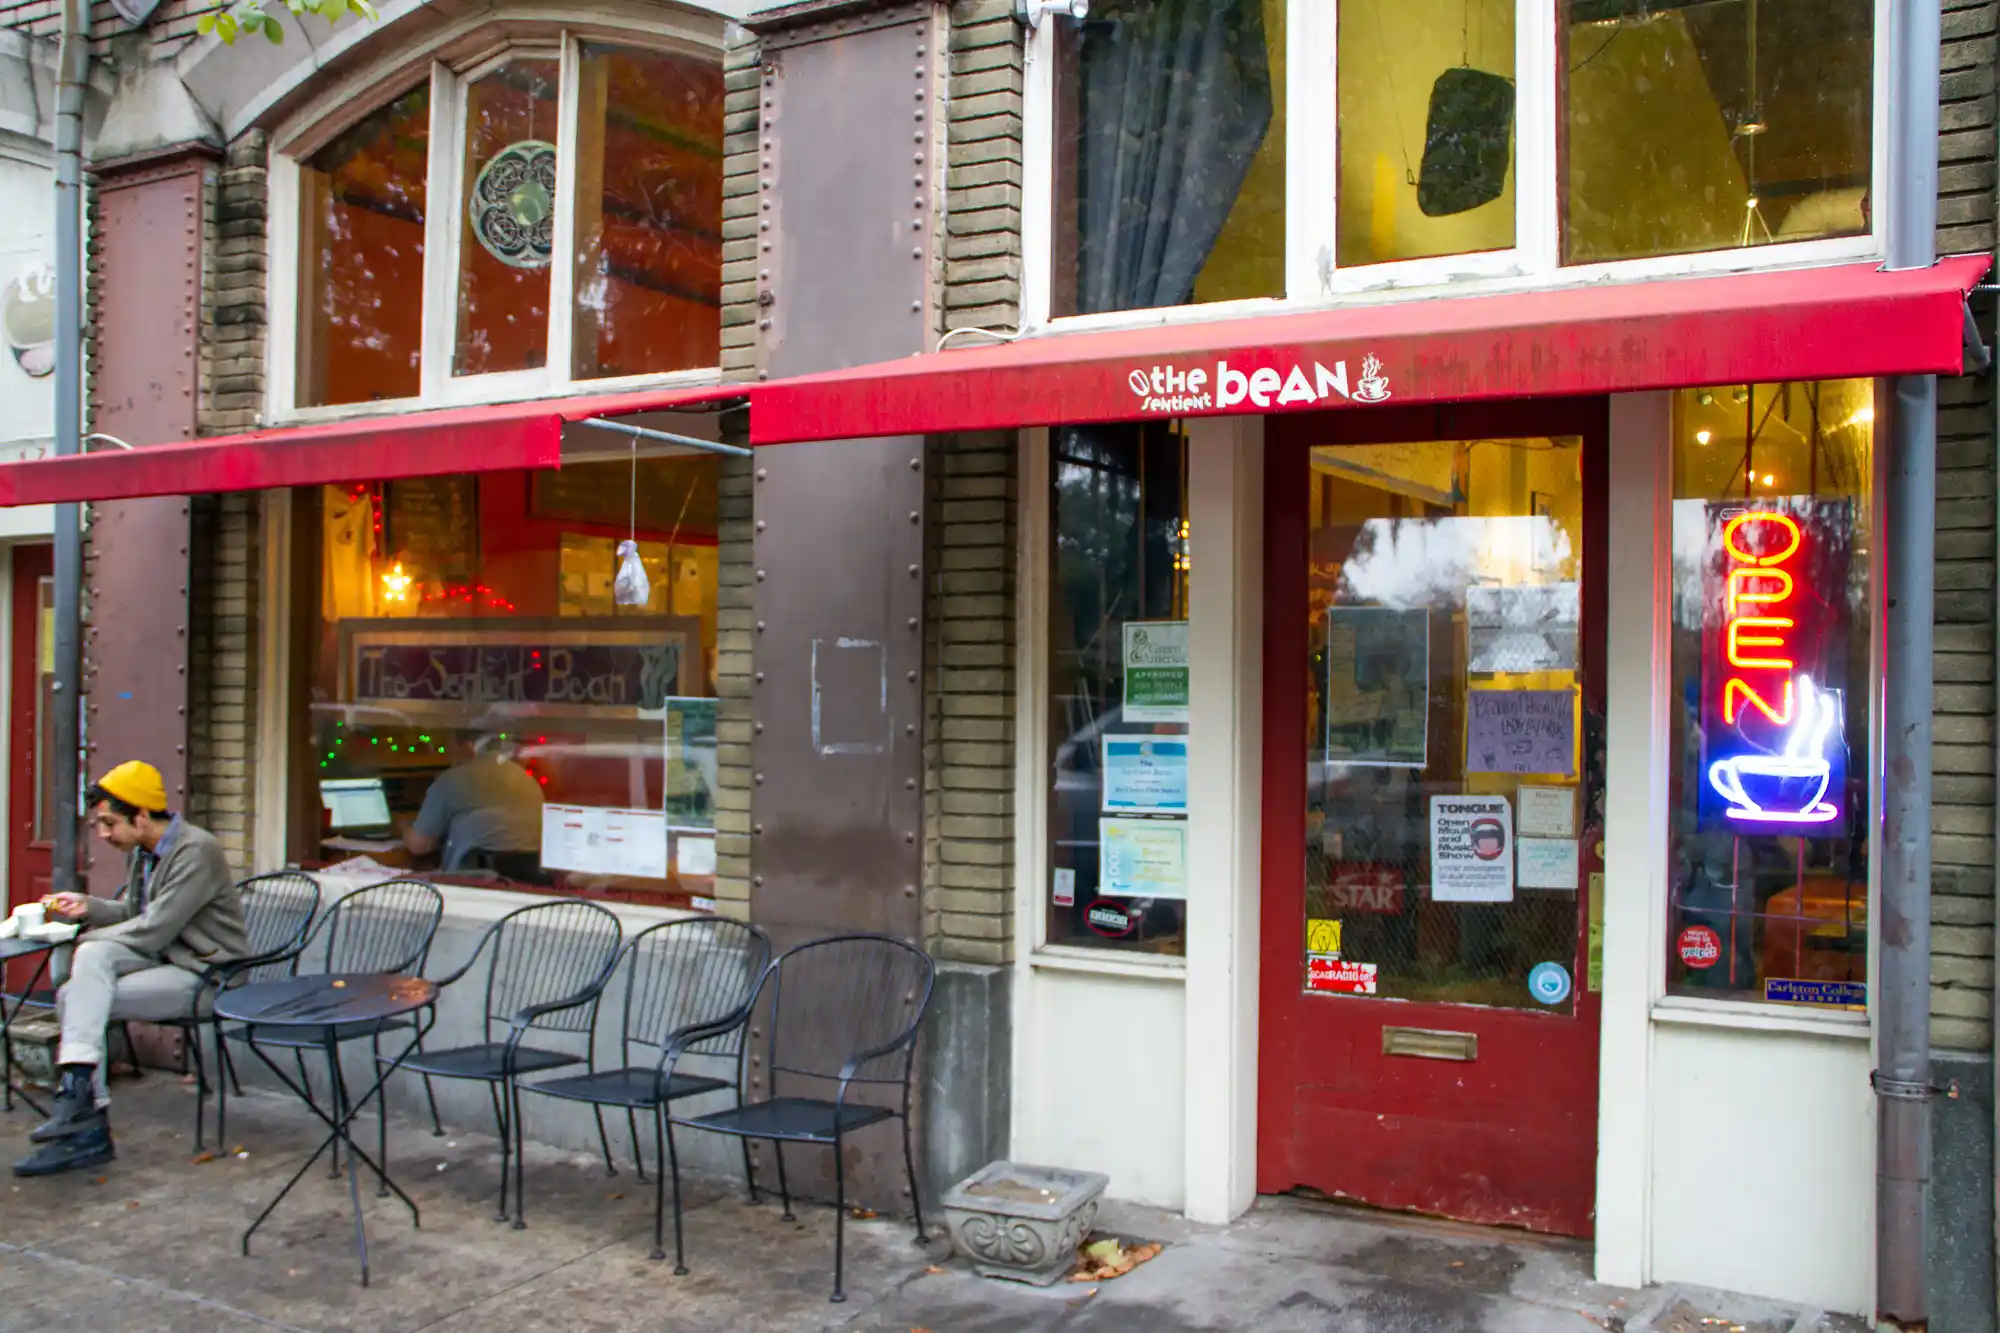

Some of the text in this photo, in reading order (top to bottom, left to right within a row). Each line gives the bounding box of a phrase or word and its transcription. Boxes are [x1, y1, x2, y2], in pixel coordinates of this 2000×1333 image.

[1723, 511, 1800, 725] OPEN
[546, 648, 628, 701] Bean
[1438, 804, 1504, 813] TONGUE
[1438, 819, 1470, 827] Open
[1332, 885, 1394, 909] STAR
[1767, 981, 1819, 994] Carleton
